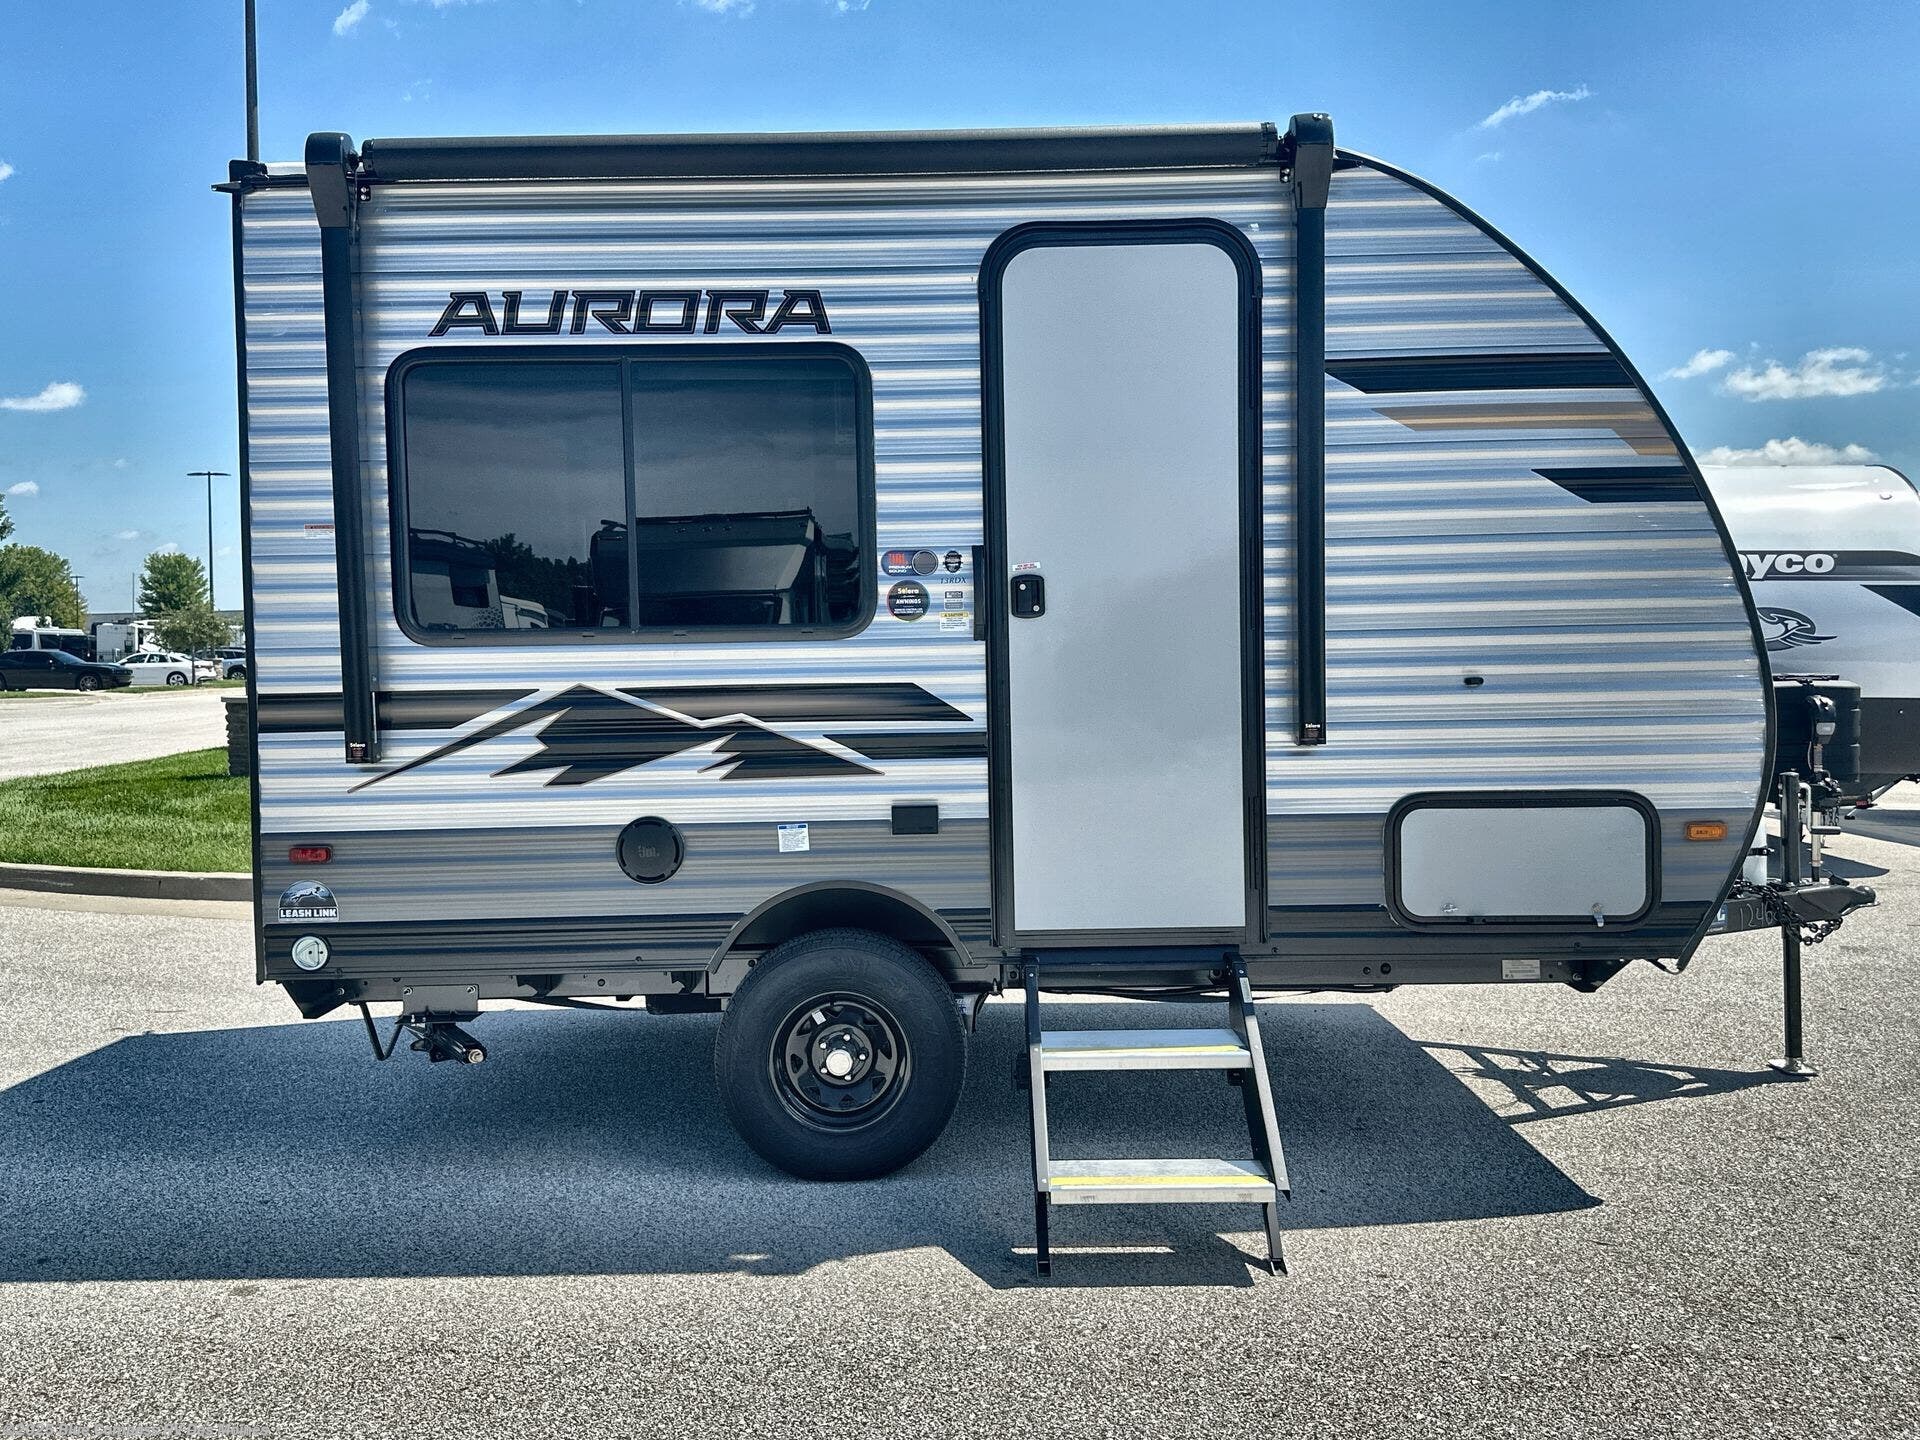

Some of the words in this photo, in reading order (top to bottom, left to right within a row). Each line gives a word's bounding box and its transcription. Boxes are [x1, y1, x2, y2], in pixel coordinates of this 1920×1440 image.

[427, 289, 832, 337] AURORA
[280, 908, 312, 918] LEASH
[313, 908, 337, 918] LINK
